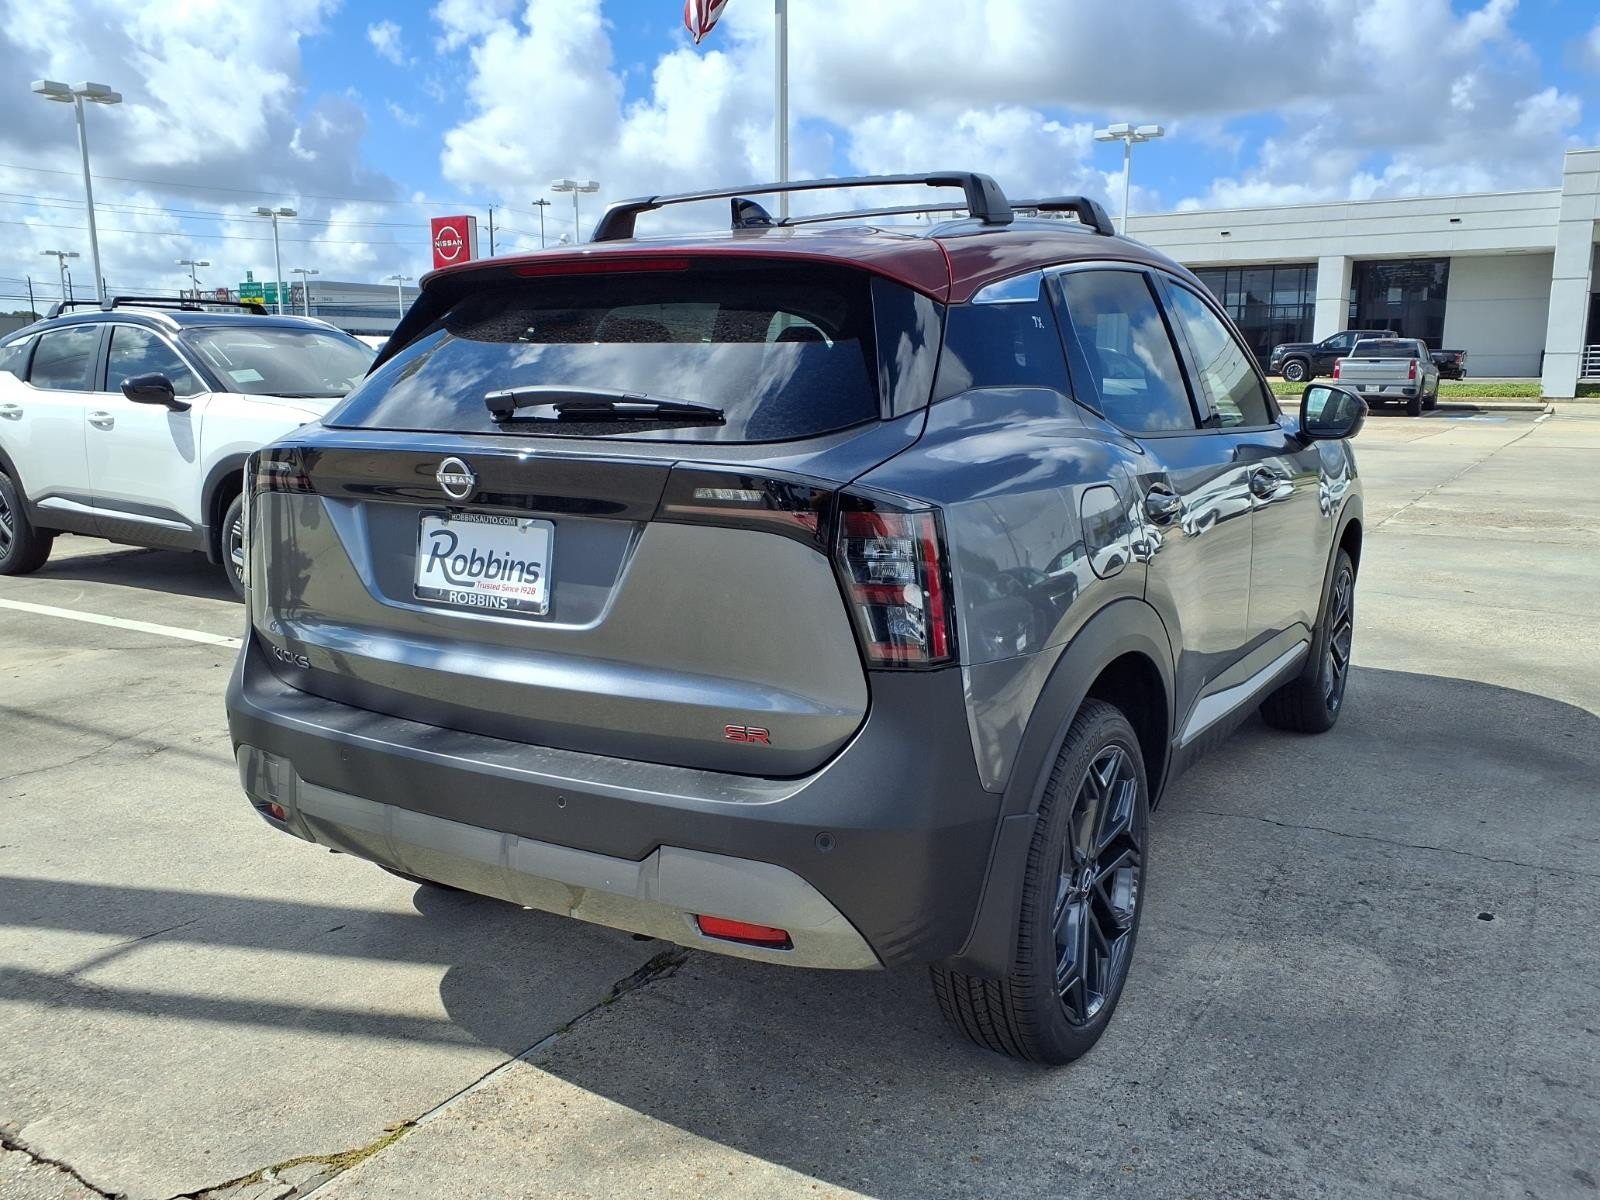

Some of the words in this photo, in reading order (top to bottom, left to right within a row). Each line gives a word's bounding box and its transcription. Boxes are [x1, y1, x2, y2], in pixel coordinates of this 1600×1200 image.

[436, 473, 475, 485] NISSAN
[426, 529, 541, 588] Robbins
[477, 581, 501, 591] Trusted
[502, 584, 519, 592] Since
[520, 586, 536, 595] 1928
[449, 591, 508, 609] ROBBINS
[724, 724, 769, 744] SR
